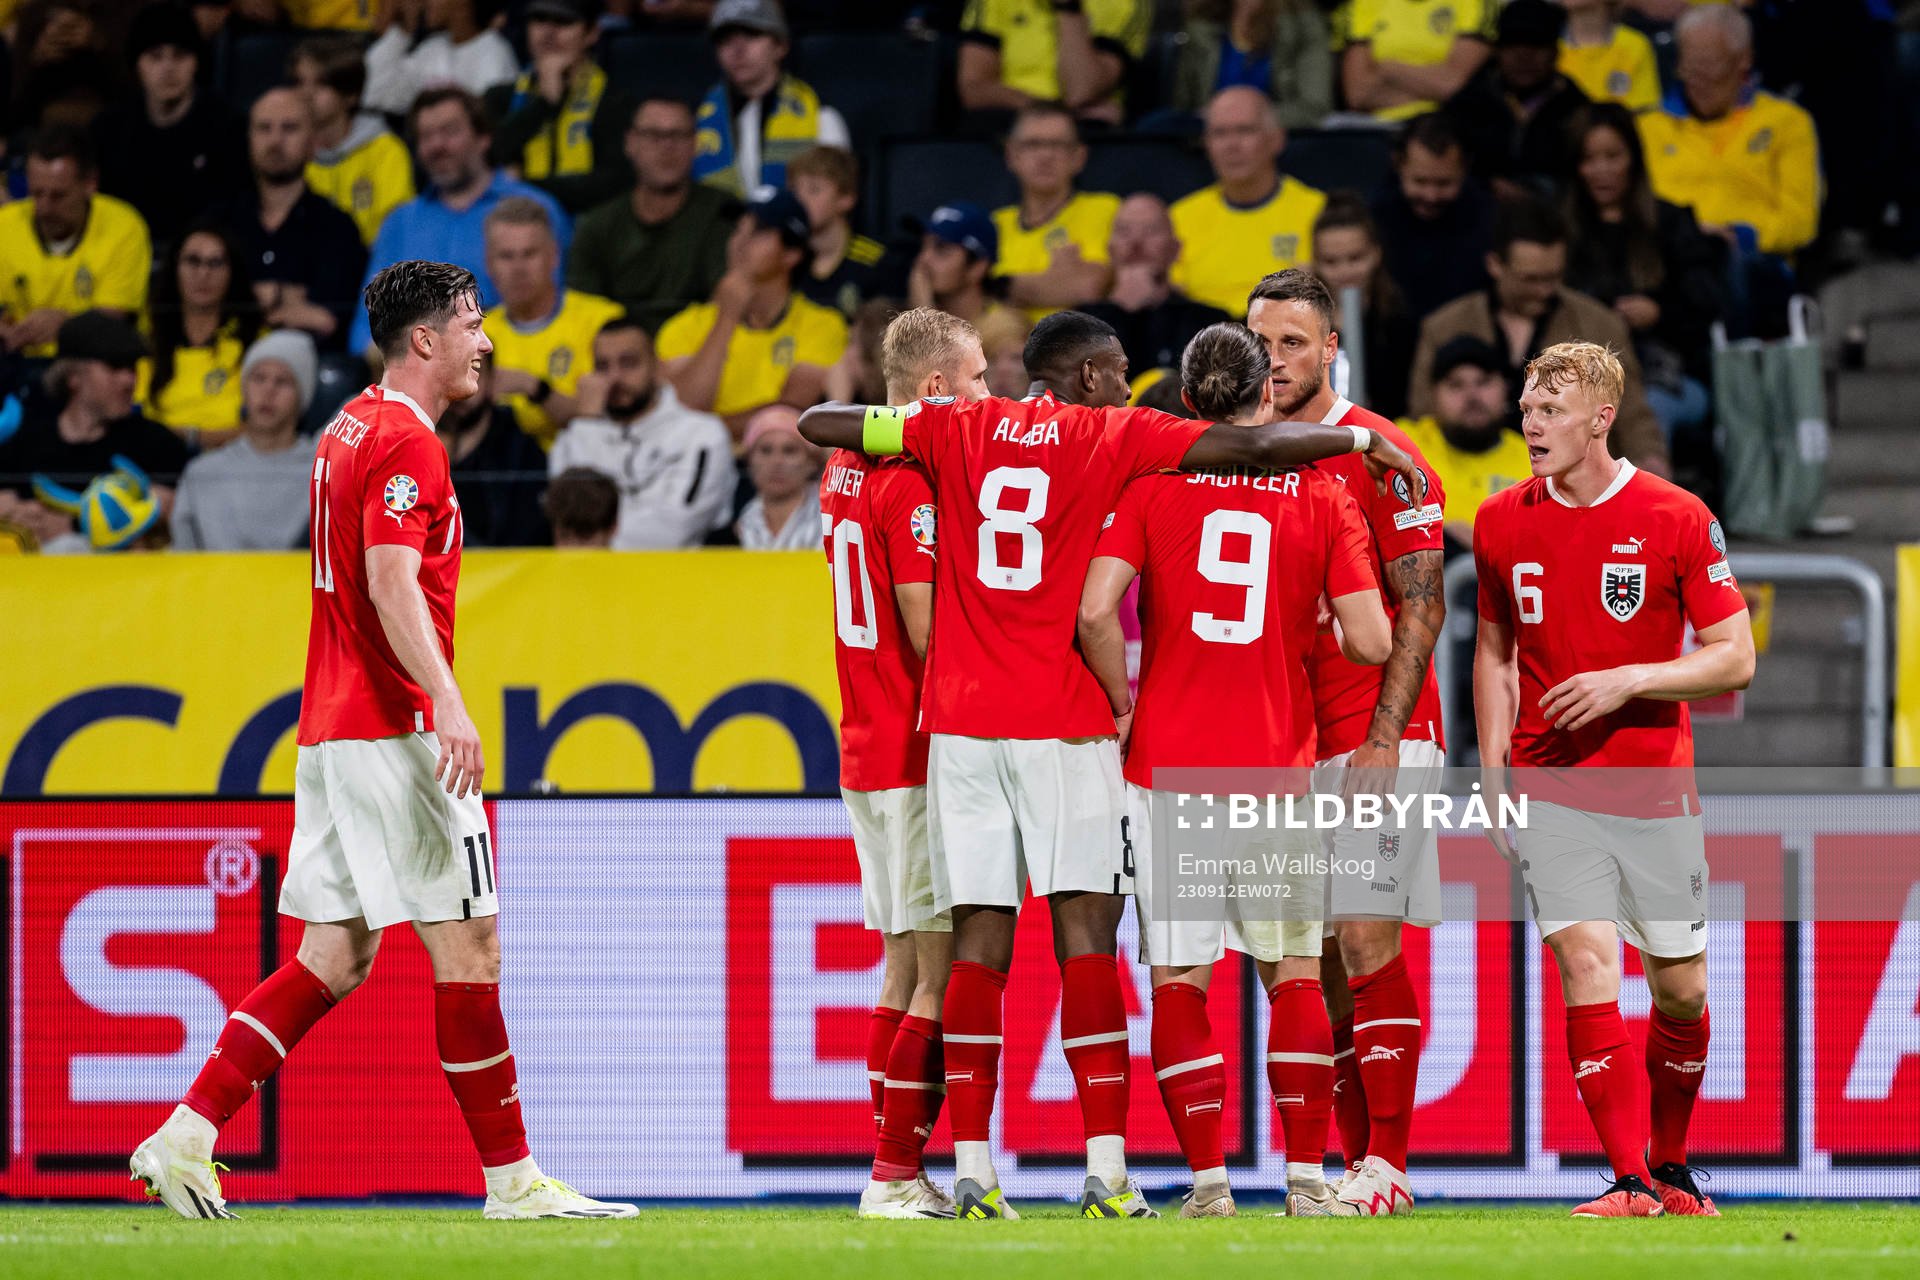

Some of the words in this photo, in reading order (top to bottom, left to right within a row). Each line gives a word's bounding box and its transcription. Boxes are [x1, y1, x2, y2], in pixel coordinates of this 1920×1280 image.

[992, 416, 1060, 449] ALABA
[976, 465, 1050, 592] 8
[1612, 543, 1639, 554] PUMA
[1191, 508, 1272, 645] 9
[1512, 562, 1544, 624] 6
[463, 831, 494, 898] 11
[1371, 881, 1396, 893] PUMA
